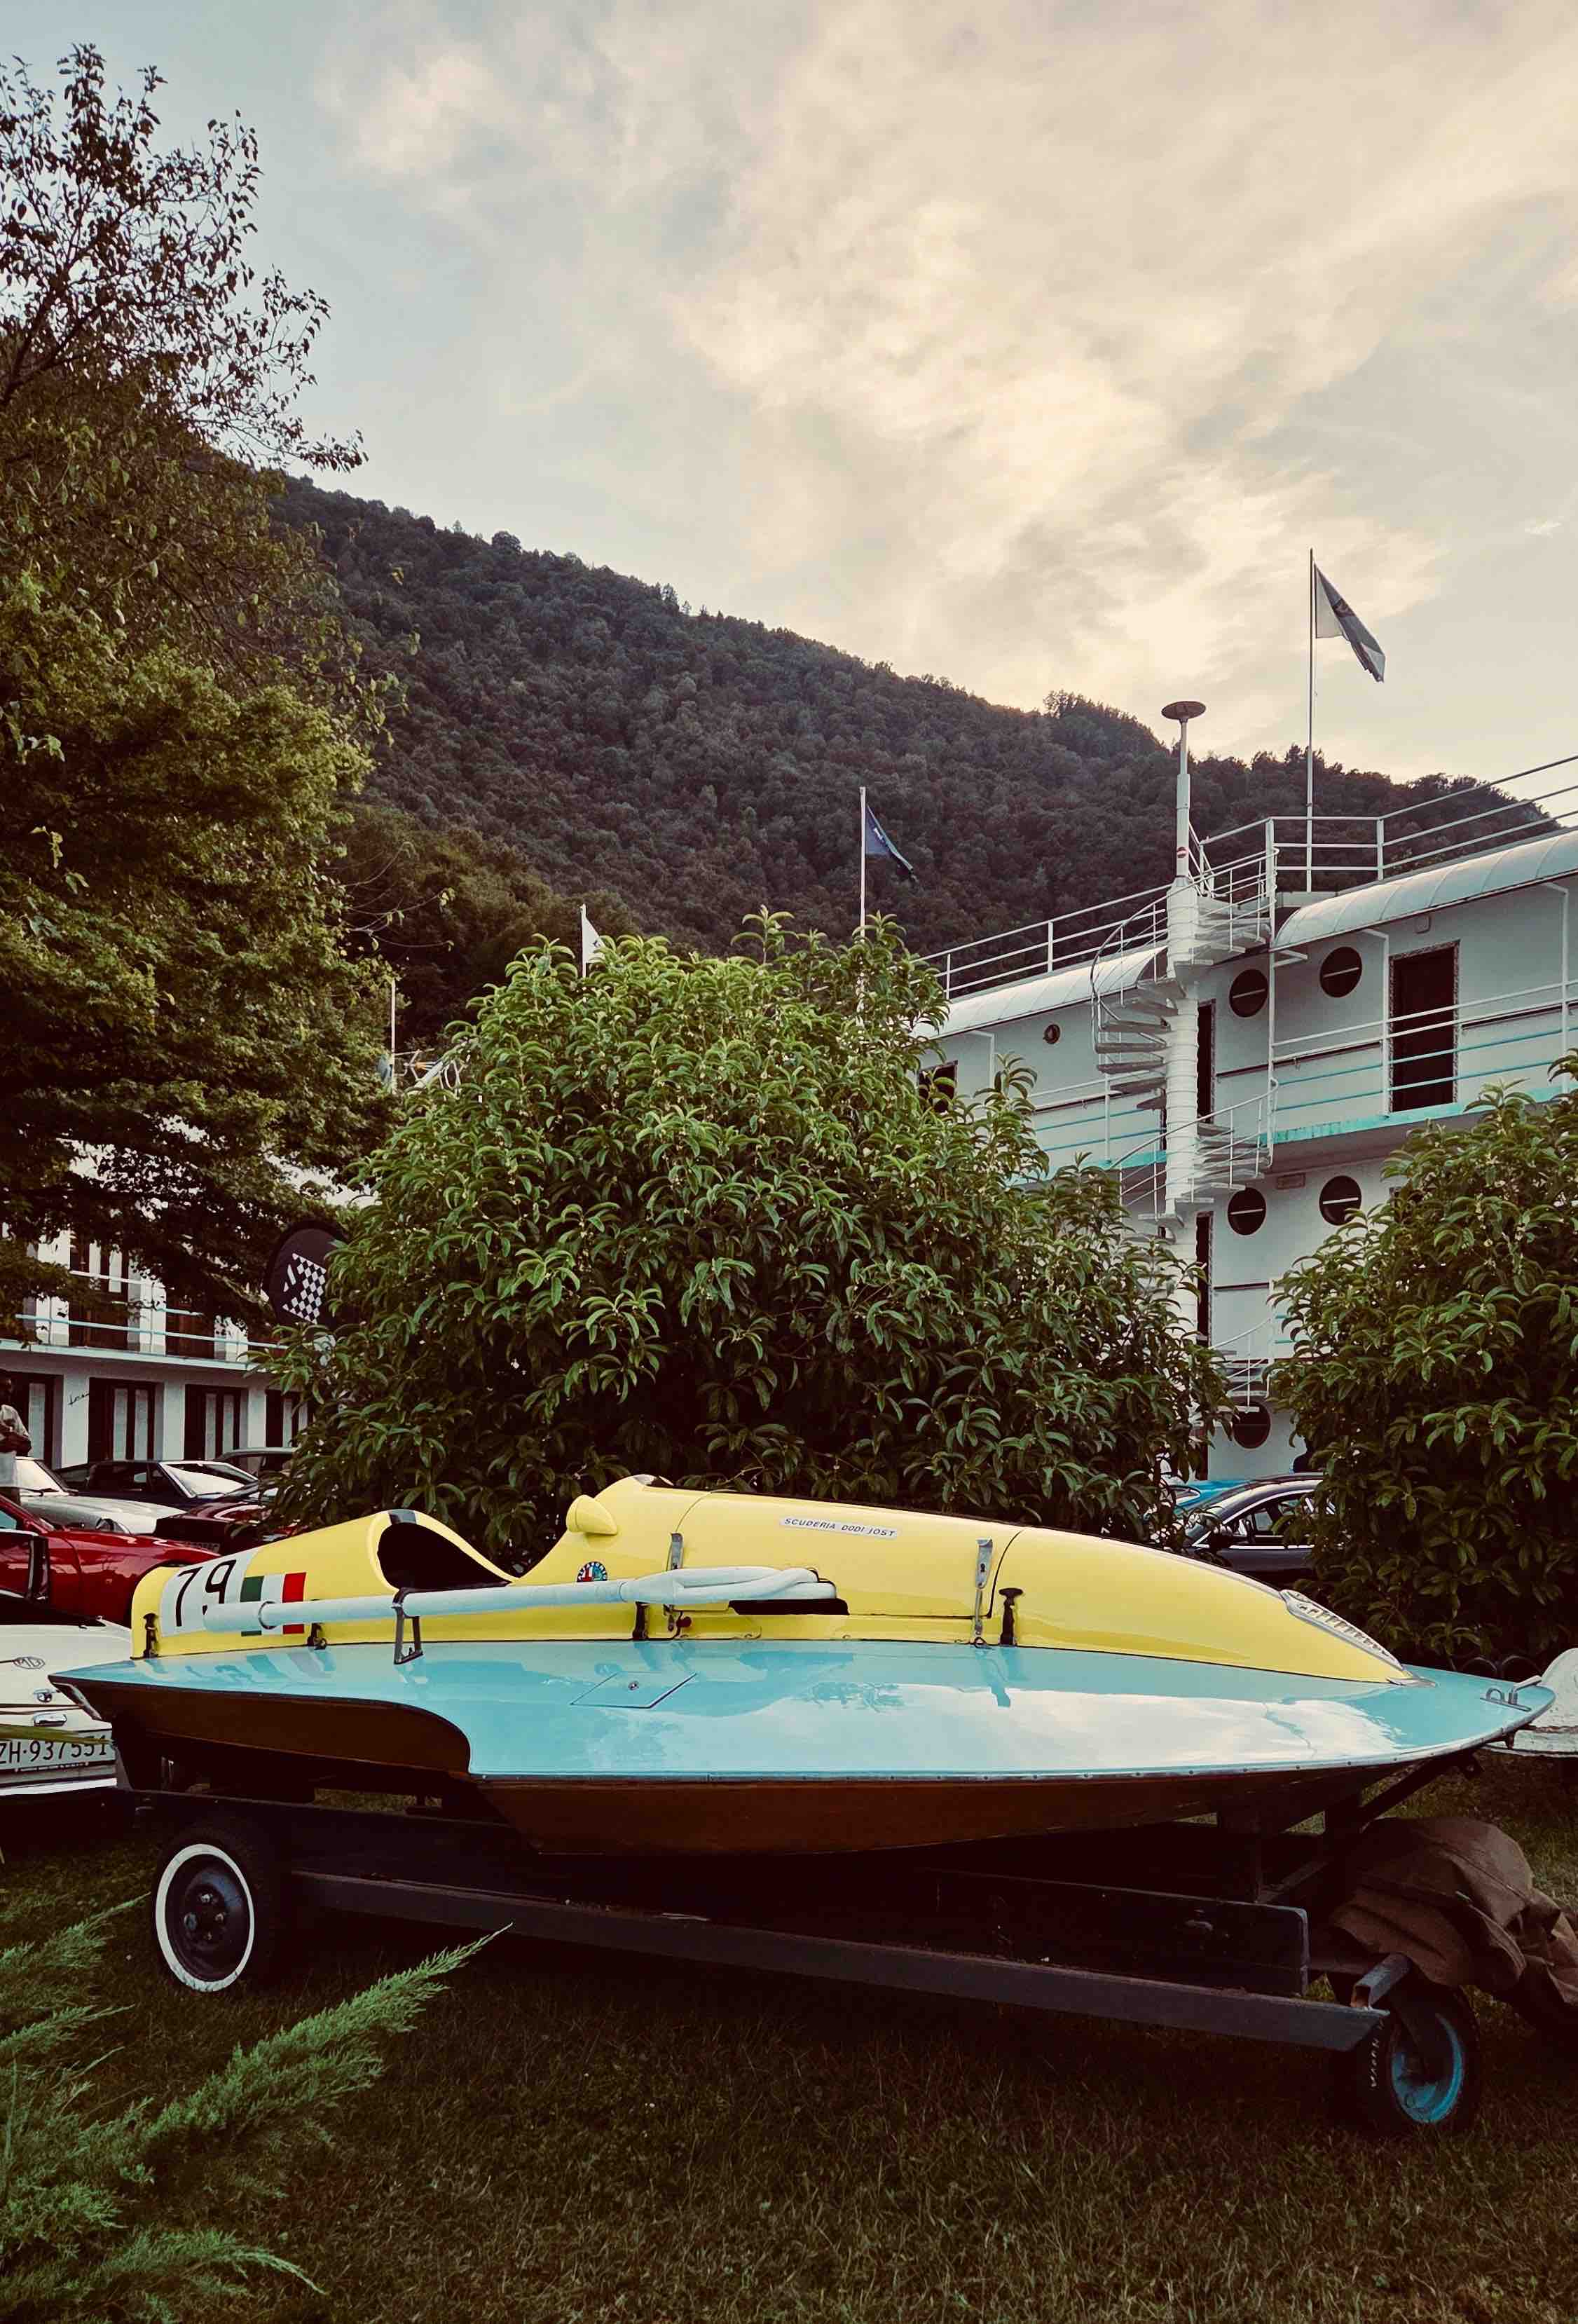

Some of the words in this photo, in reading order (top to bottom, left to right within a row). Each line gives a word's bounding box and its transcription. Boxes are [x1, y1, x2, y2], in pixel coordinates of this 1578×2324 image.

[784, 1518, 836, 1529] SCUDERIA
[867, 1529, 896, 1537] JOST
[175, 1559, 237, 1627] 79
